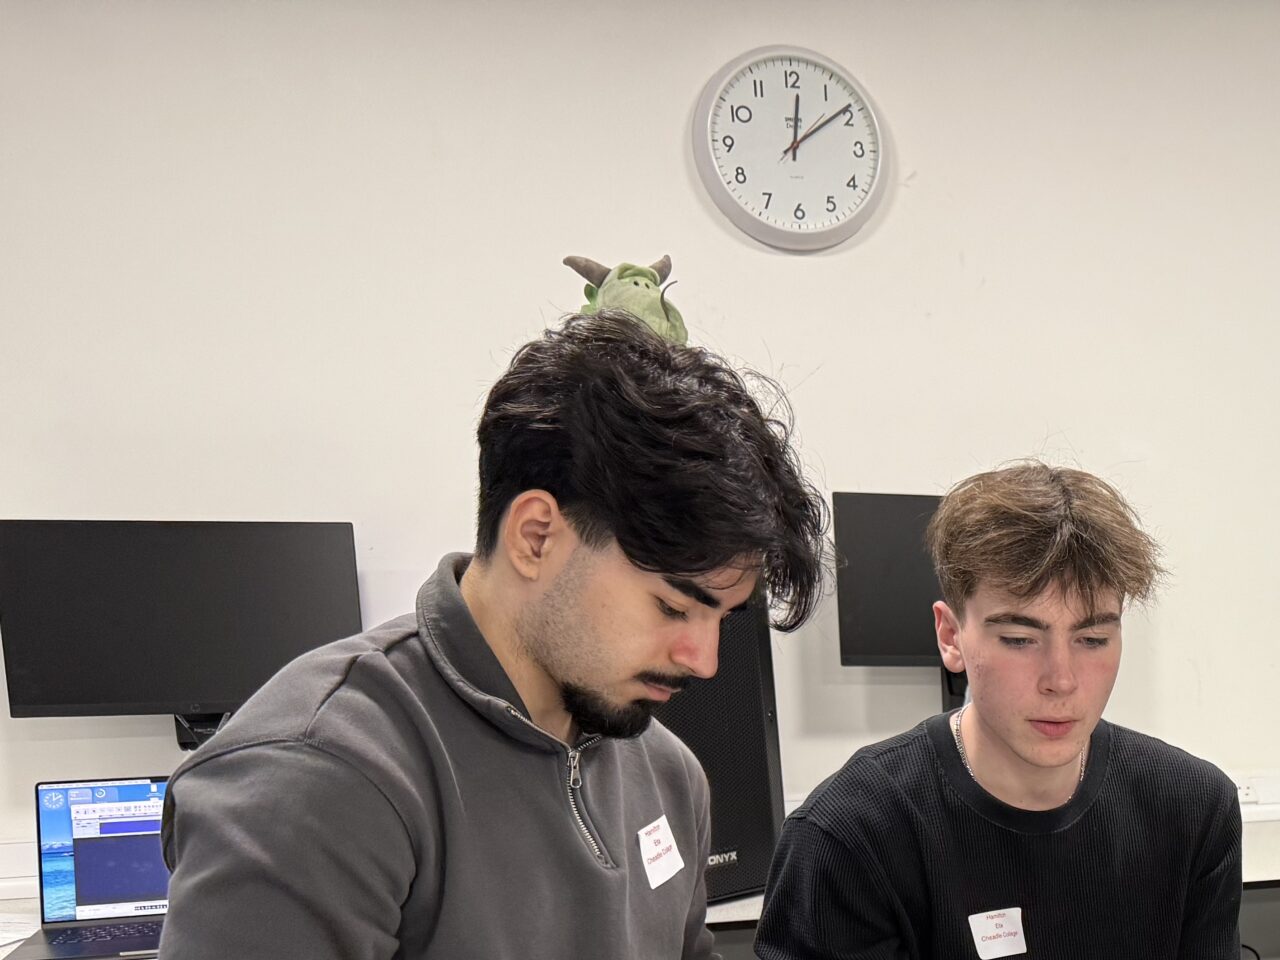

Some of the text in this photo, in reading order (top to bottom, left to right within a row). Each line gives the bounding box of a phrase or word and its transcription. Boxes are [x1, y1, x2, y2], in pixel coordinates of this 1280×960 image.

[784, 70, 800, 88] 12
[753, 79, 764, 98] 11
[730, 104, 752, 123] 10
[843, 107, 854, 126] 2
[722, 135, 734, 152] 9
[853, 141, 865, 158] 3
[735, 166, 747, 184] 8
[846, 174, 858, 190] 4
[762, 192, 772, 209] 7
[826, 196, 837, 213] 5
[793, 203, 805, 220] 6
